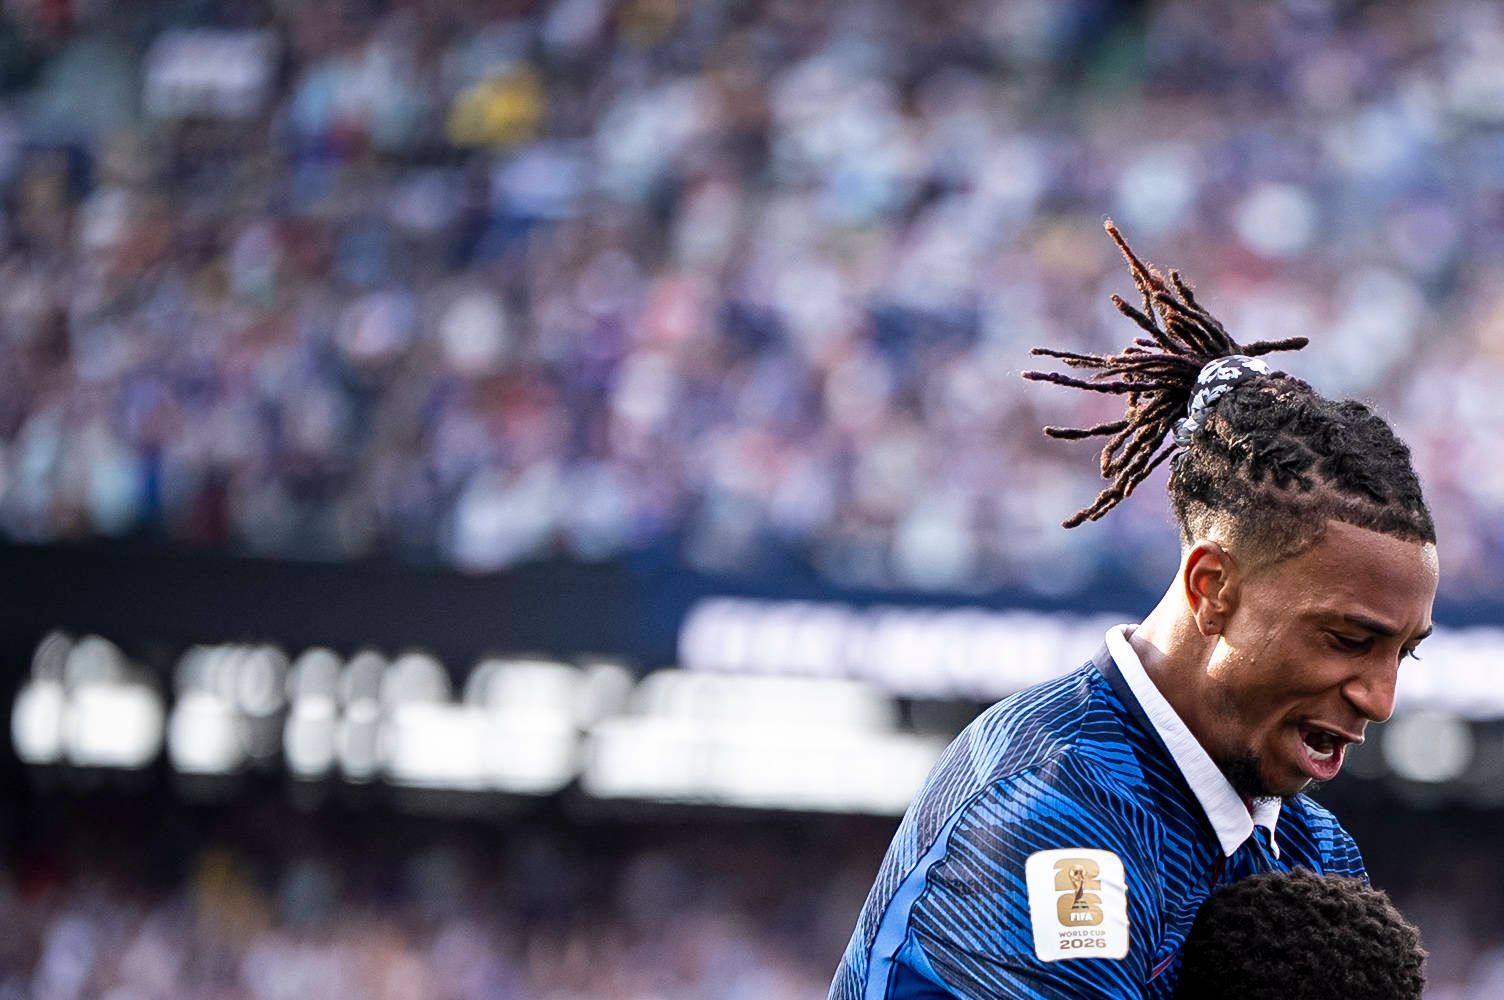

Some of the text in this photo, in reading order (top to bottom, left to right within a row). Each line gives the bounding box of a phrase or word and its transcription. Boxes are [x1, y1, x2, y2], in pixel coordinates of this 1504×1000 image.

[1070, 912, 1093, 921] FIFA
[1059, 930, 1088, 938] WORLD
[1060, 938, 1106, 949] 2026
